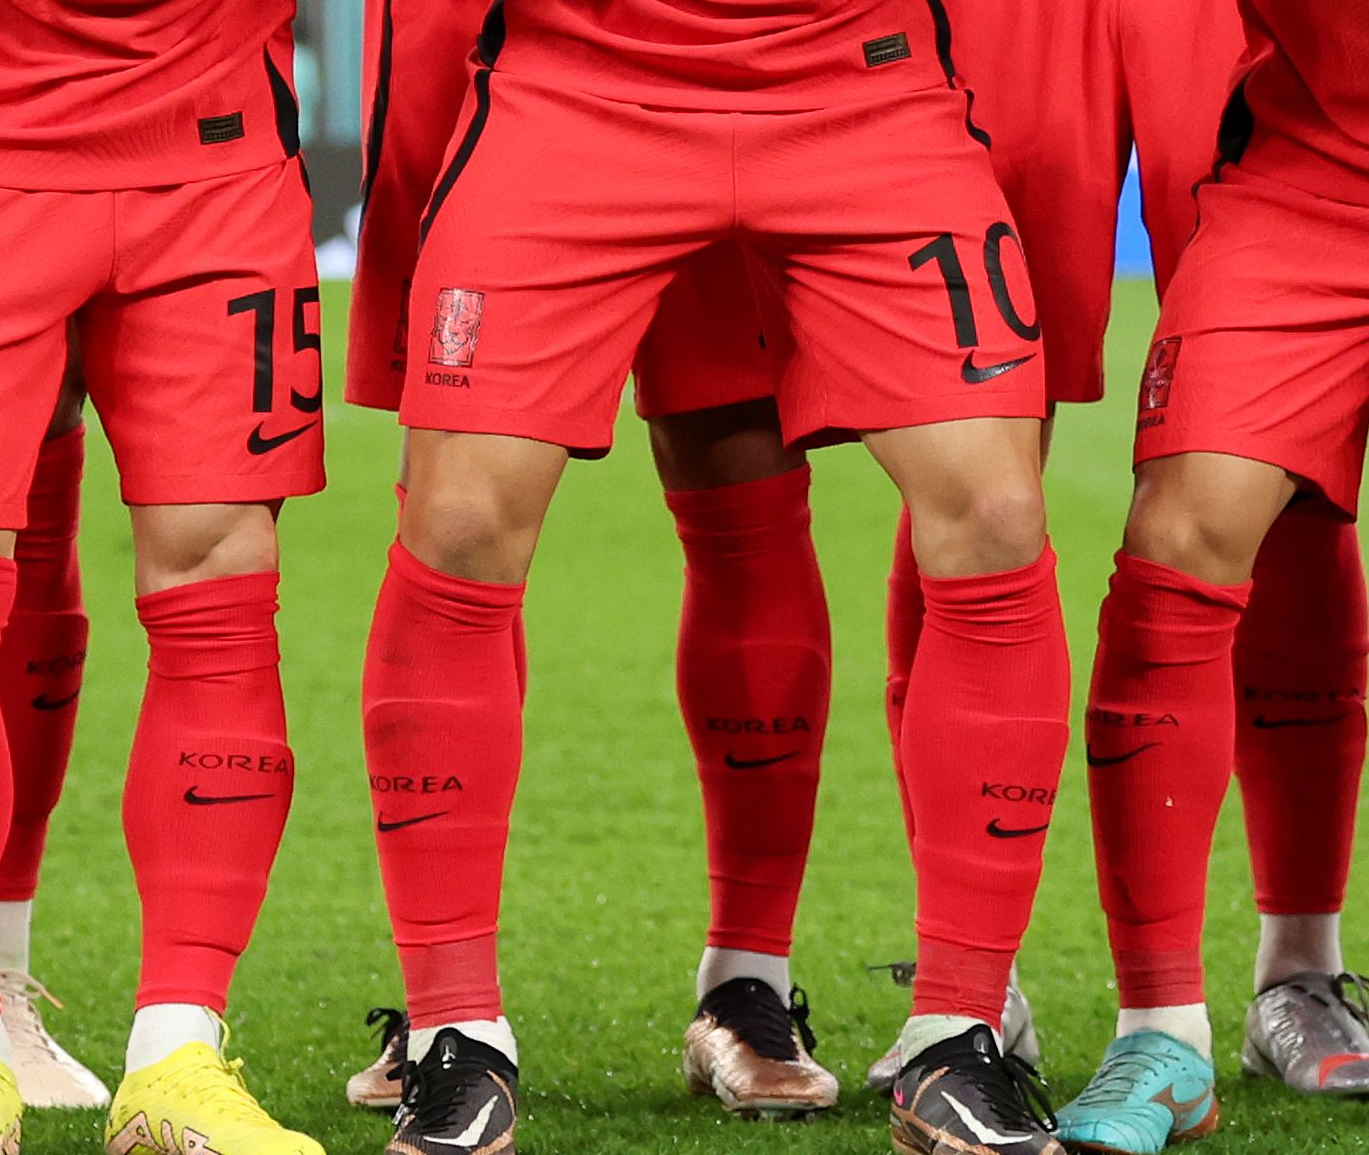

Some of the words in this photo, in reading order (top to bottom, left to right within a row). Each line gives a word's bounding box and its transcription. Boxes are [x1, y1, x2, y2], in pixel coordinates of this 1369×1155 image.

[907, 221, 1042, 348] 10
[227, 286, 322, 413] 15
[425, 371, 471, 390] KOREA
[706, 716, 811, 735] KOREA
[179, 751, 290, 776] KOREA
[369, 775, 464, 794] KOREA
